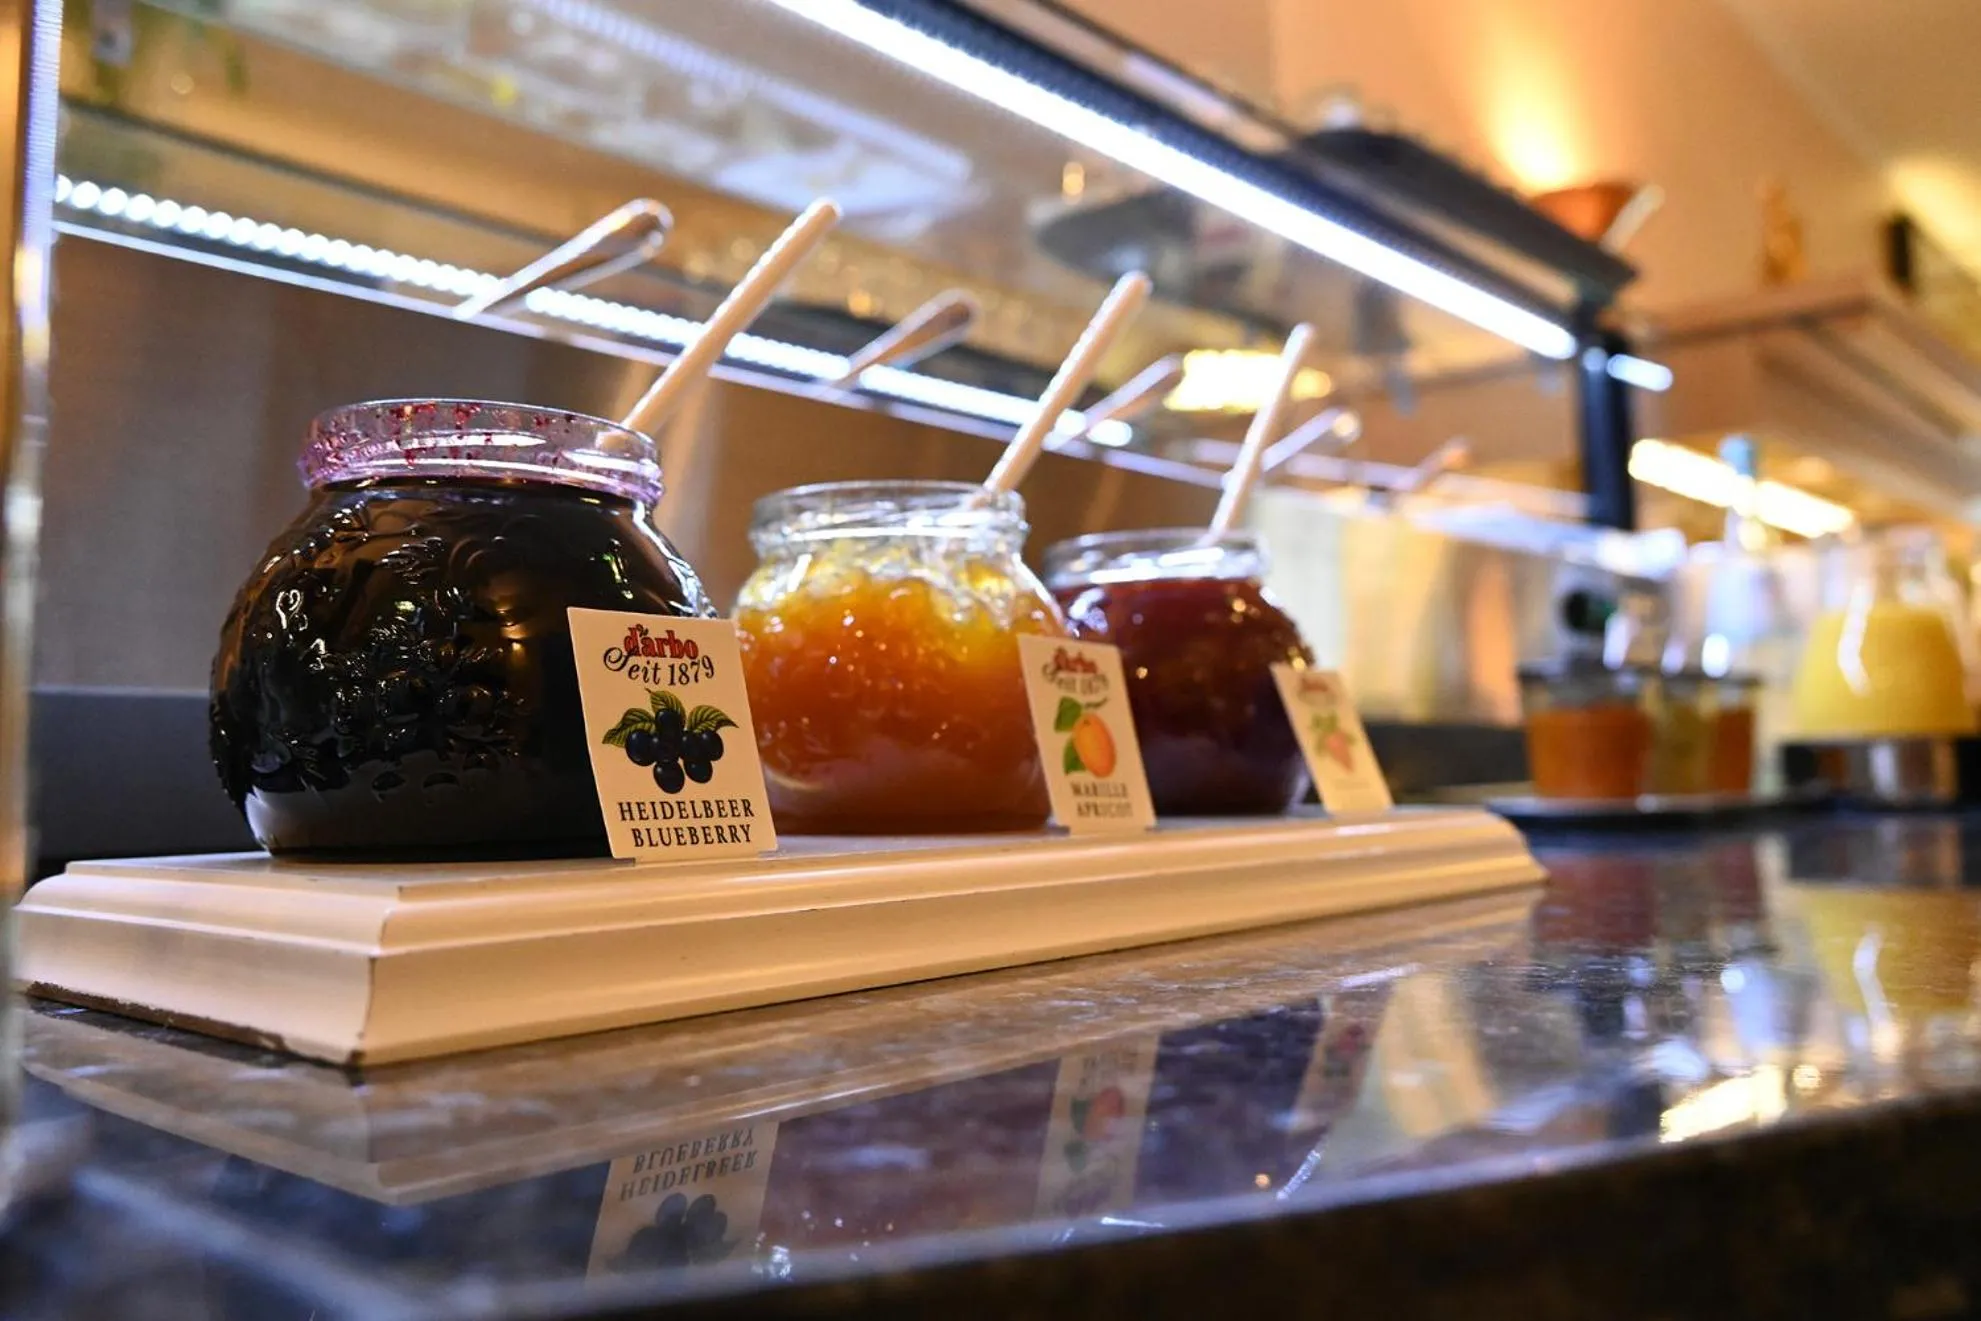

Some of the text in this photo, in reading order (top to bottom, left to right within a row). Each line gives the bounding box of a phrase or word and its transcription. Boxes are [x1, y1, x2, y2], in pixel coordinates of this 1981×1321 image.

[603, 646, 715, 687] Seit 1879
[618, 798, 755, 822] HEIDELBEER
[631, 823, 752, 849] BLUEBERRY
